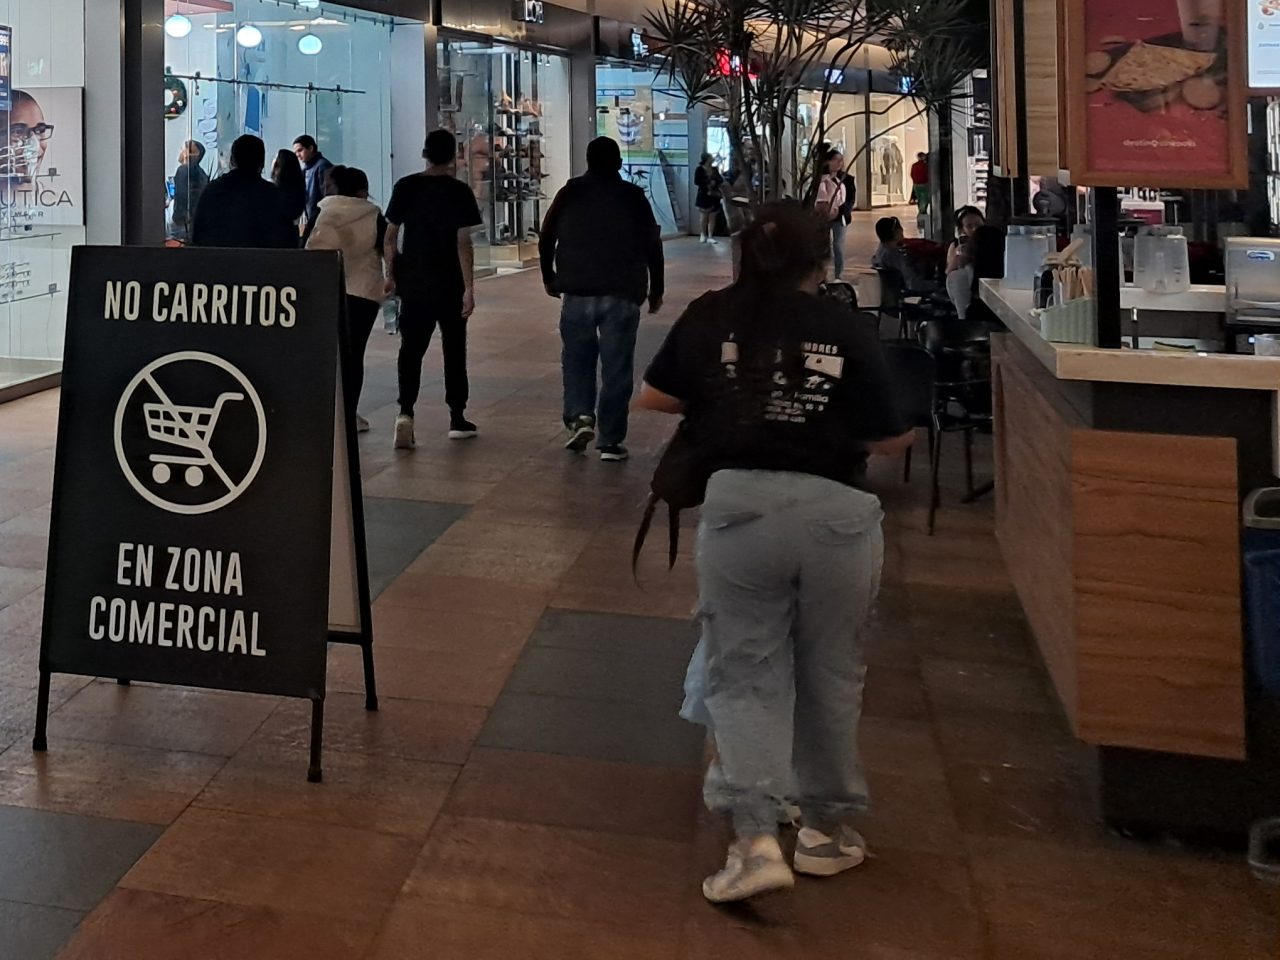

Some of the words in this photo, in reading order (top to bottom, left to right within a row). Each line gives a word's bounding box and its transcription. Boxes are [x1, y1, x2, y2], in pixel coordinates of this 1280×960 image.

[104, 280, 141, 321] NO
[152, 281, 298, 328] CARRITOS
[117, 542, 154, 587] EN
[164, 546, 244, 597] ZONA
[88, 595, 267, 658] COMERCIAL
